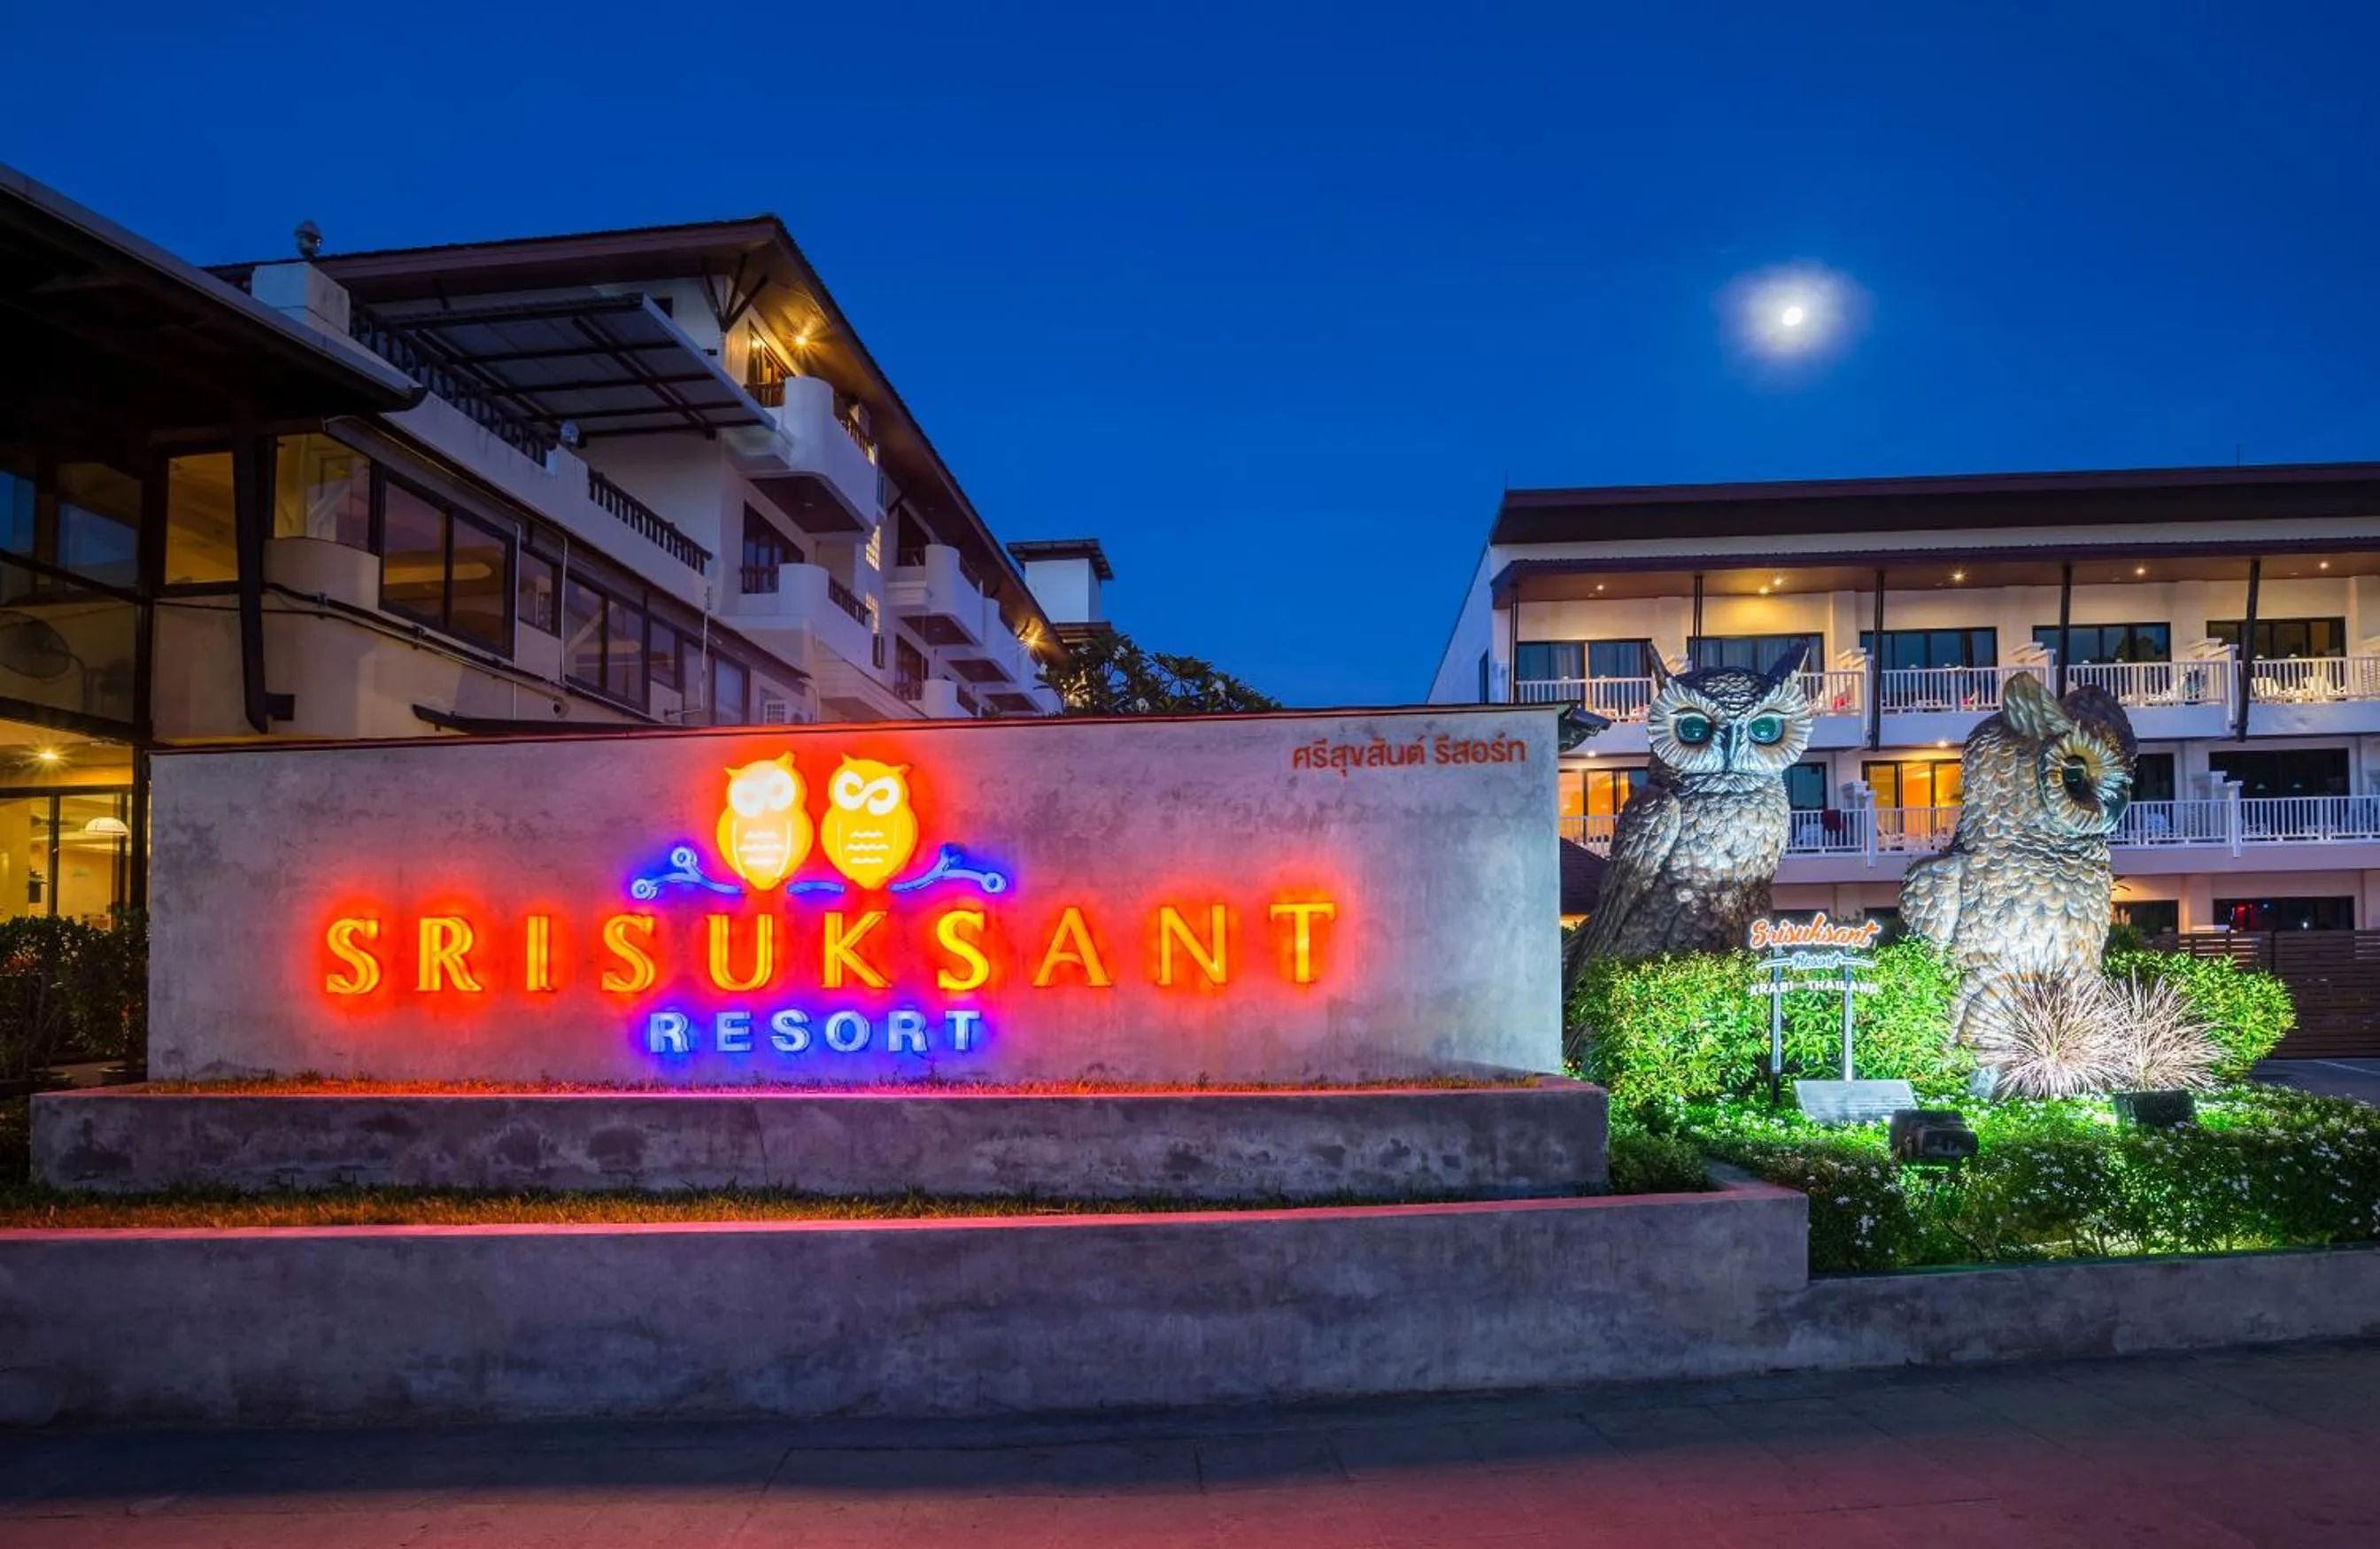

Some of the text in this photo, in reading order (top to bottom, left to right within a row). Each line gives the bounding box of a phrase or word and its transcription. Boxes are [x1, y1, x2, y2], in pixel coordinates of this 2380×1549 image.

[326, 902, 1337, 995] SRISUKSANT
[1749, 980, 1880, 996] KRABI THAILAND
[648, 1011, 982, 1053] RESORT
